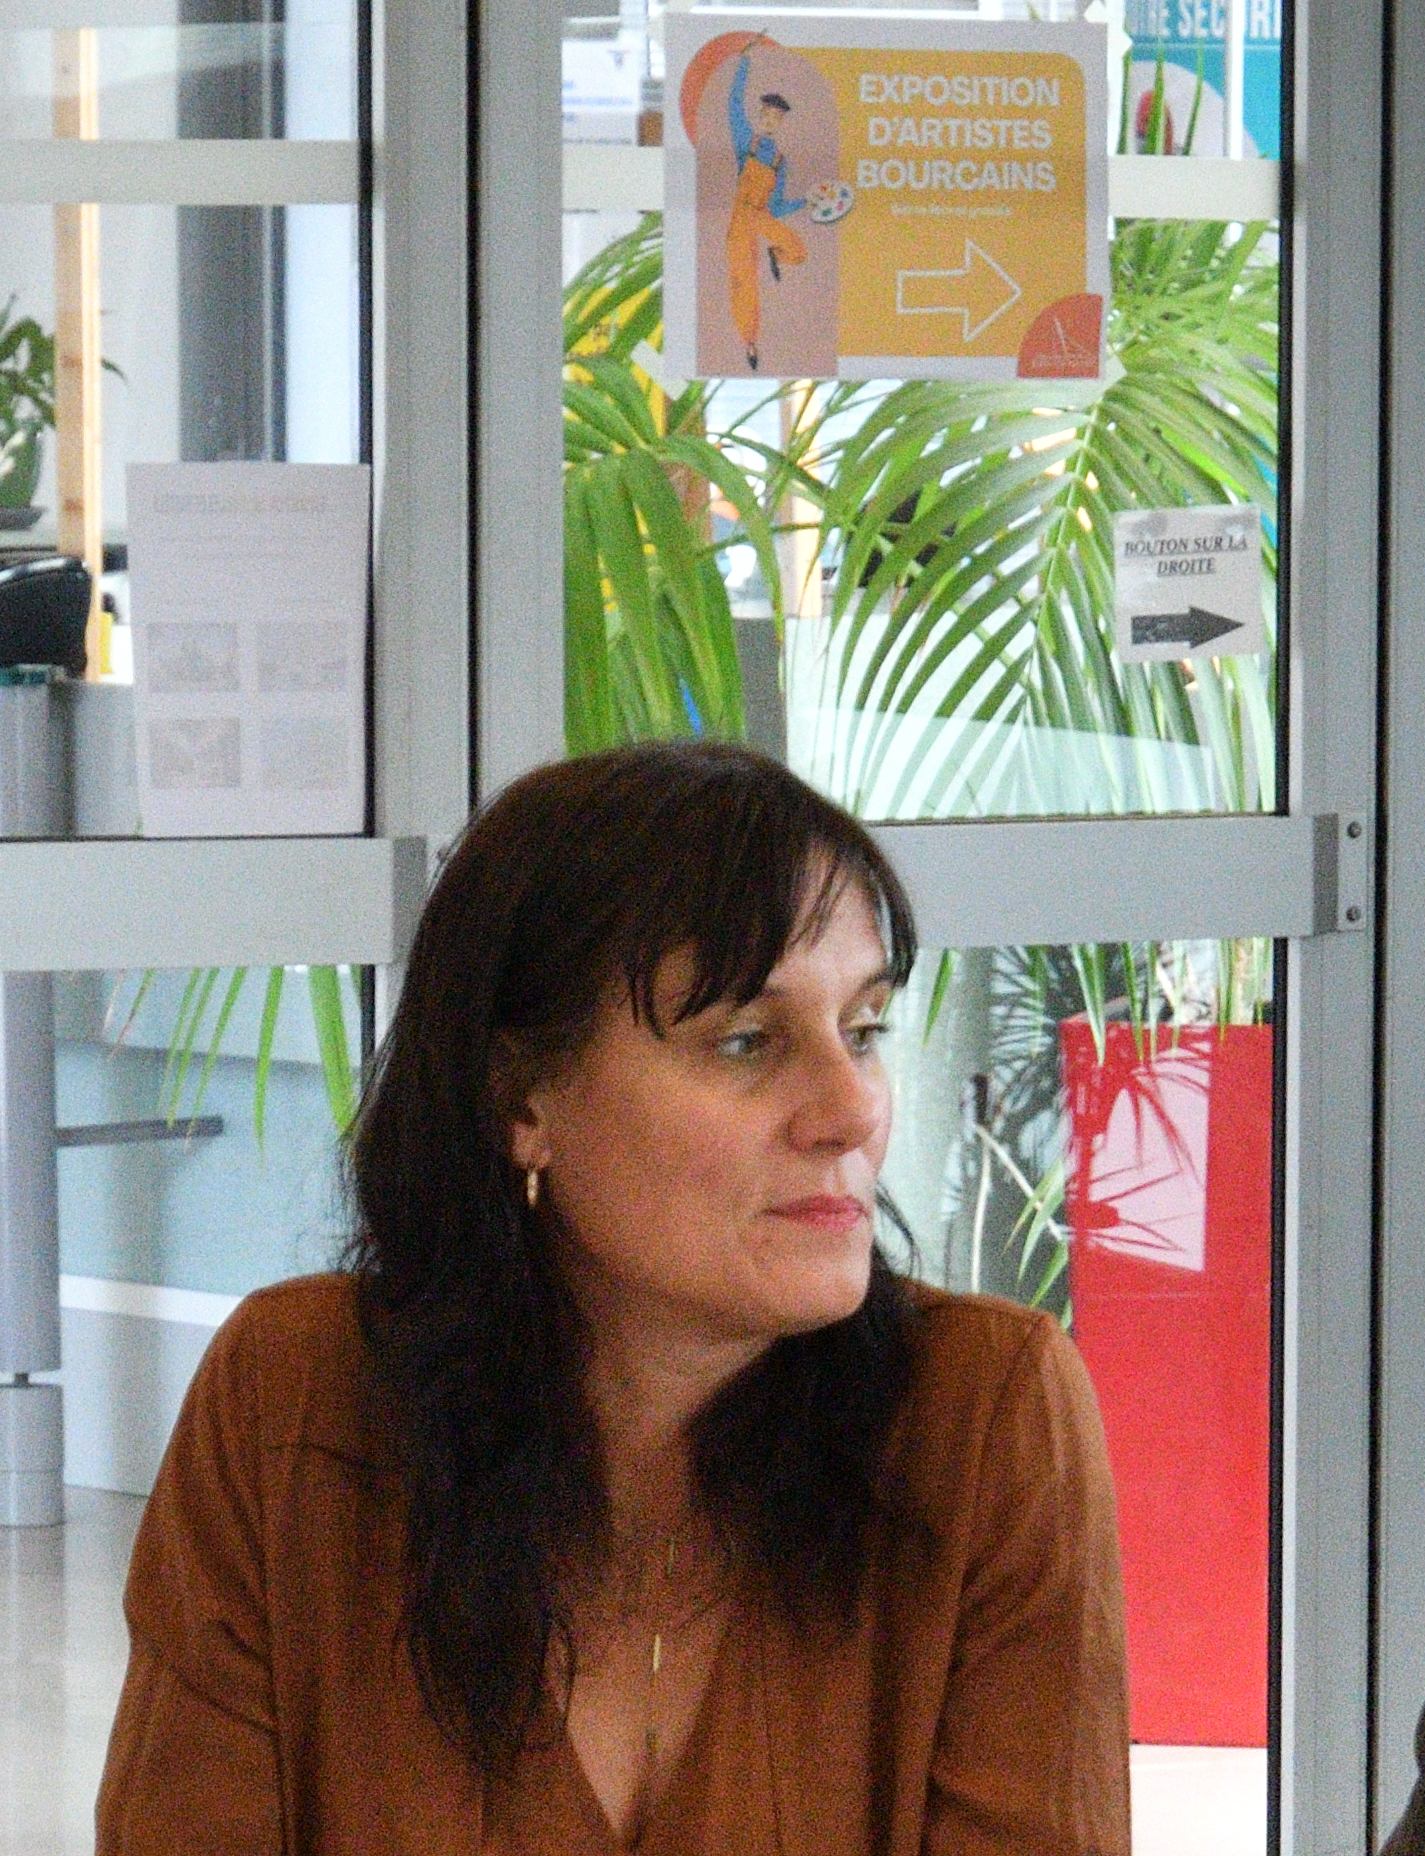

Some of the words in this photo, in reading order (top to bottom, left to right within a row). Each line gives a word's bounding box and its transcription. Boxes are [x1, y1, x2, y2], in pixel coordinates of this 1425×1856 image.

[858, 73, 1060, 107] EXPOSITION
[868, 116, 1052, 149] D'ARTISTES
[856, 158, 1056, 191] BOURCAINS
[1124, 538, 1188, 556] BOUTON
[1193, 536, 1223, 551] SUR
[1228, 534, 1248, 550] LA
[1157, 557, 1216, 576] DROITE
